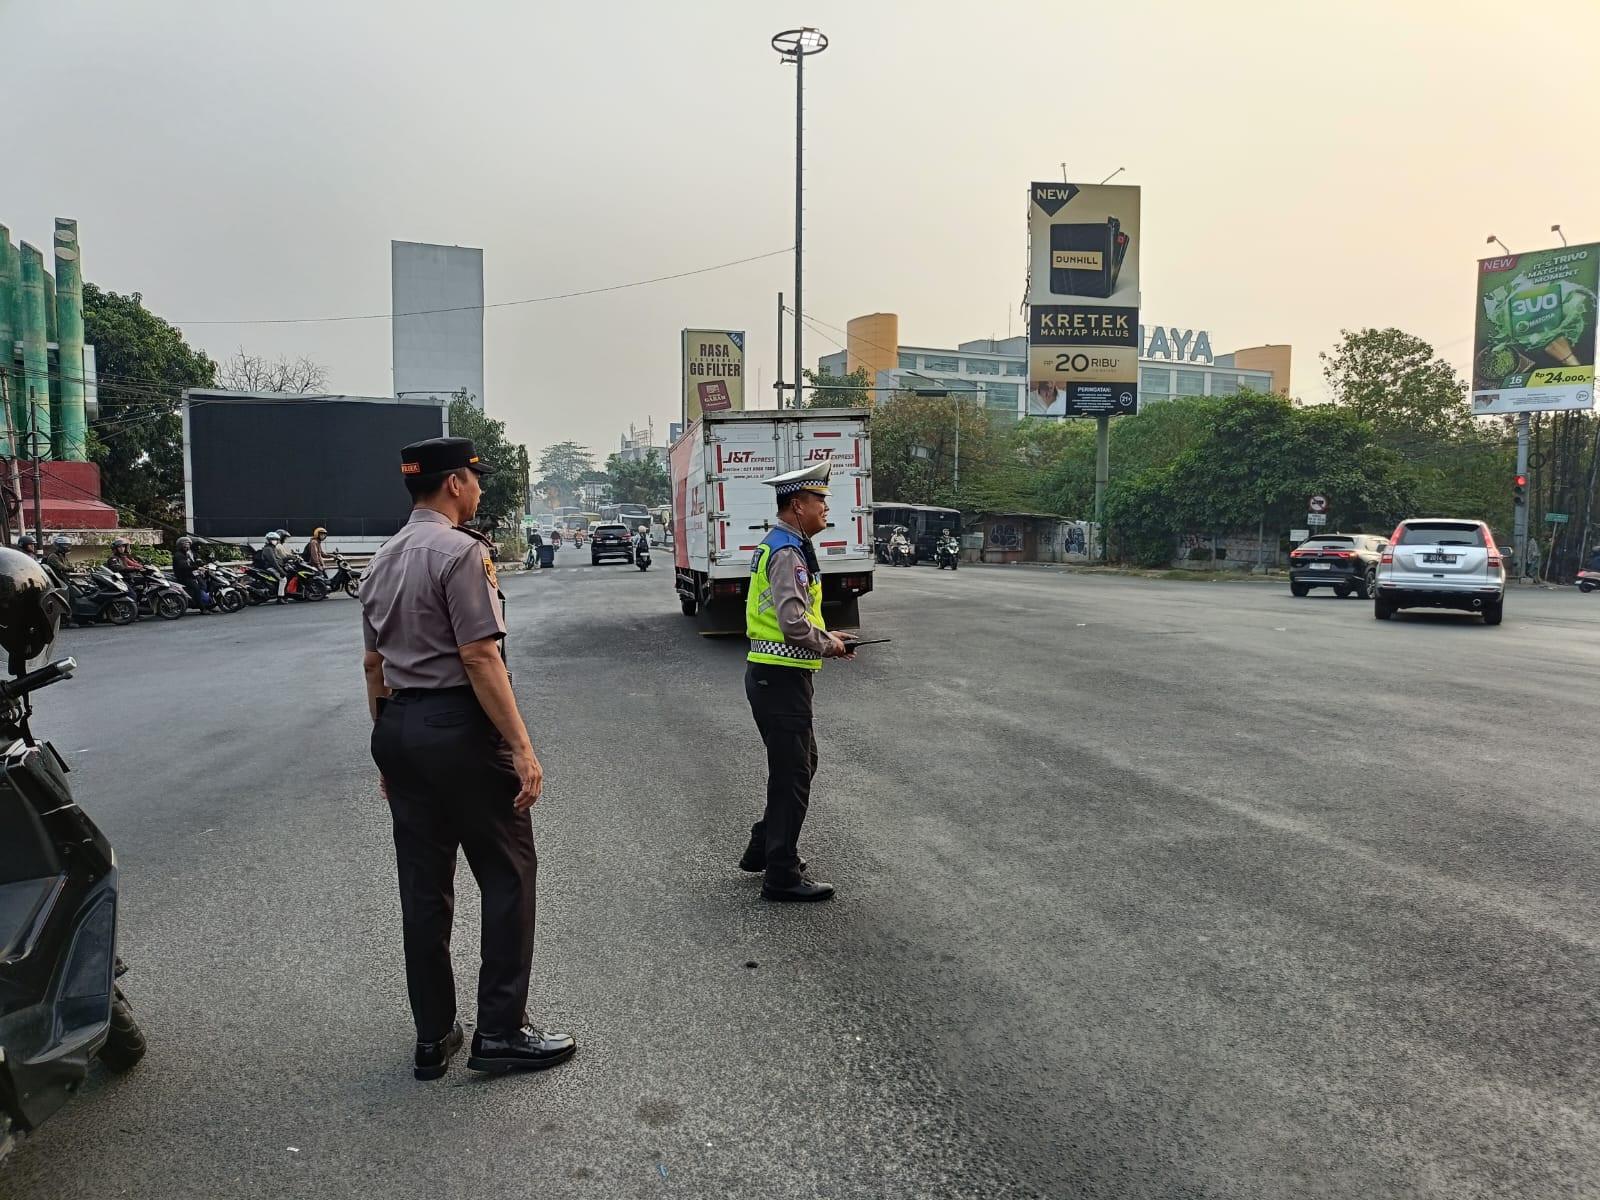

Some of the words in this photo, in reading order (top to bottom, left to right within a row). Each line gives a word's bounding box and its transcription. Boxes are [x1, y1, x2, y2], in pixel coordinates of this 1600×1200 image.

[1036, 188, 1069, 200] NEW
[1055, 255, 1098, 265] DUNHILL
[1483, 257, 1513, 271] NEW
[1532, 261, 1552, 270] IT'S
[1552, 250, 1588, 265] TRIVO
[1527, 264, 1569, 279] MATCHA
[1533, 268, 1580, 285] MOMENT
[1040, 313, 1129, 329] KRETEK
[1040, 328, 1088, 336] MANTAP
[1092, 329, 1129, 338] HALUS
[700, 343, 730, 358] RASA
[689, 362, 705, 376] GG
[706, 363, 741, 377] FILTER
[1055, 353, 1090, 373] 20
[1509, 375, 1522, 385] 16
[1534, 371, 1545, 379] Rp
[722, 451, 755, 464] J&T
[803, 448, 836, 462] J&T
